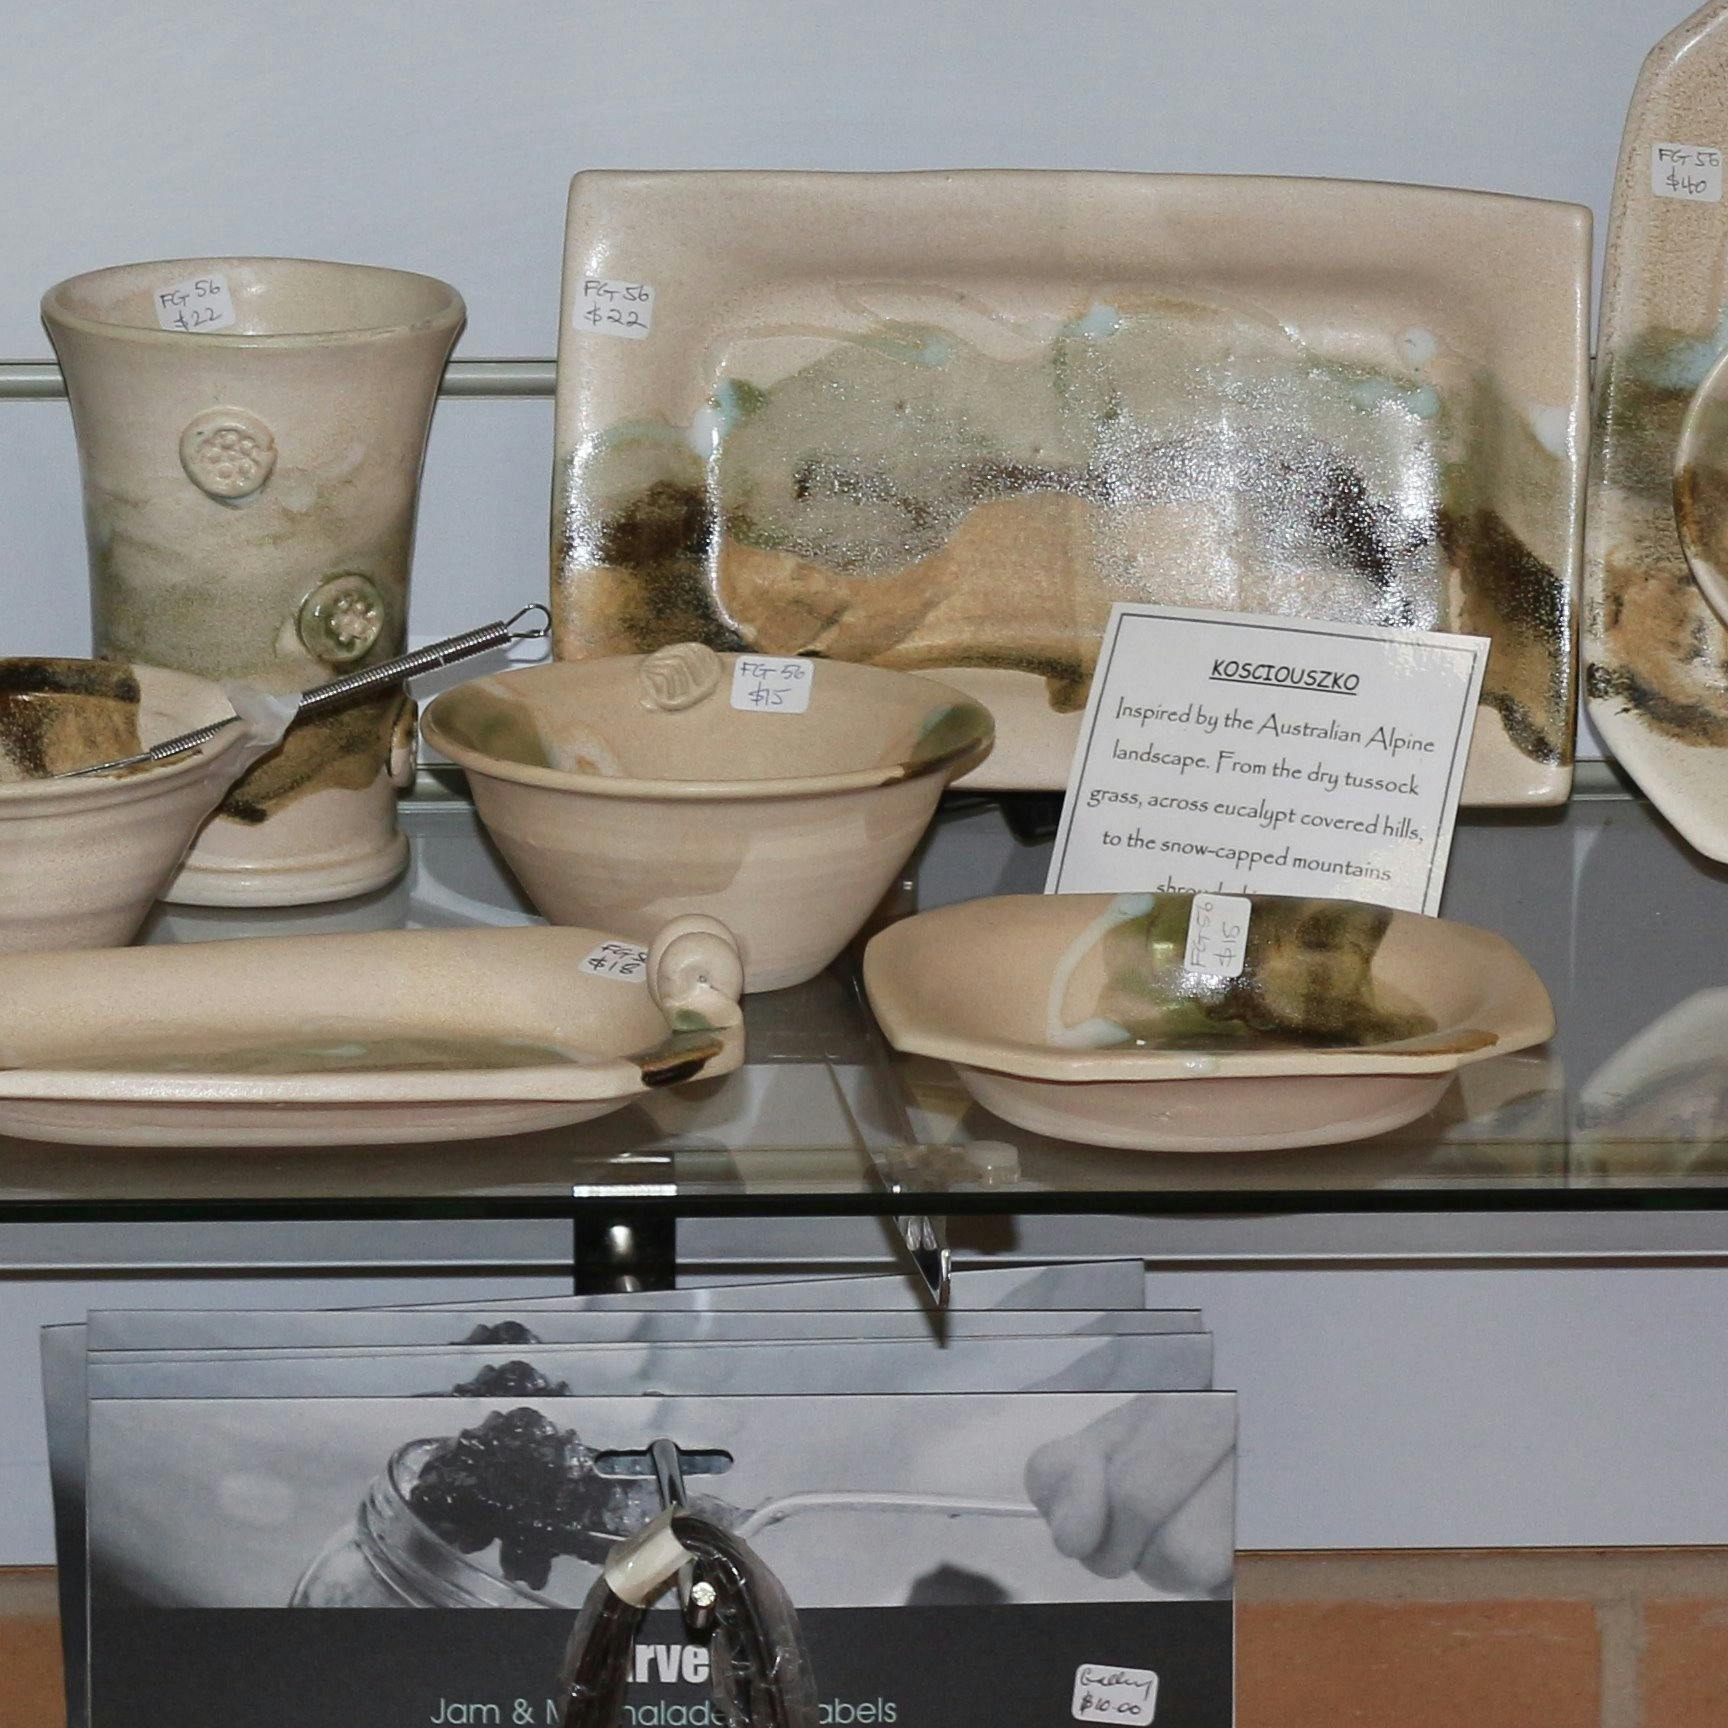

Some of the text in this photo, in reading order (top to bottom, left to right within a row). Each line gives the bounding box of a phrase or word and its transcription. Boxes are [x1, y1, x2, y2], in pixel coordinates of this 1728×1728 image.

[1666, 166, 1707, 195] $40
[195, 279, 220, 298] 56
[623, 285, 649, 302] 56
[173, 307, 224, 331] $22
[584, 300, 649, 329] $22
[1209, 659, 1360, 693] KOSCIOUSZKO
[1116, 696, 1435, 757] Inspired by the Australian Alpine
[1113, 739, 1420, 796] landscape. From the dry tussock
[1087, 789, 1424, 843] grass, across eucalypt covered hills,
[1102, 827, 1391, 882] to the snow-capped mountains
[1212, 921, 1240, 968] $15
[430, 1698, 500, 1725] Jam
[512, 1698, 535, 1725] &
